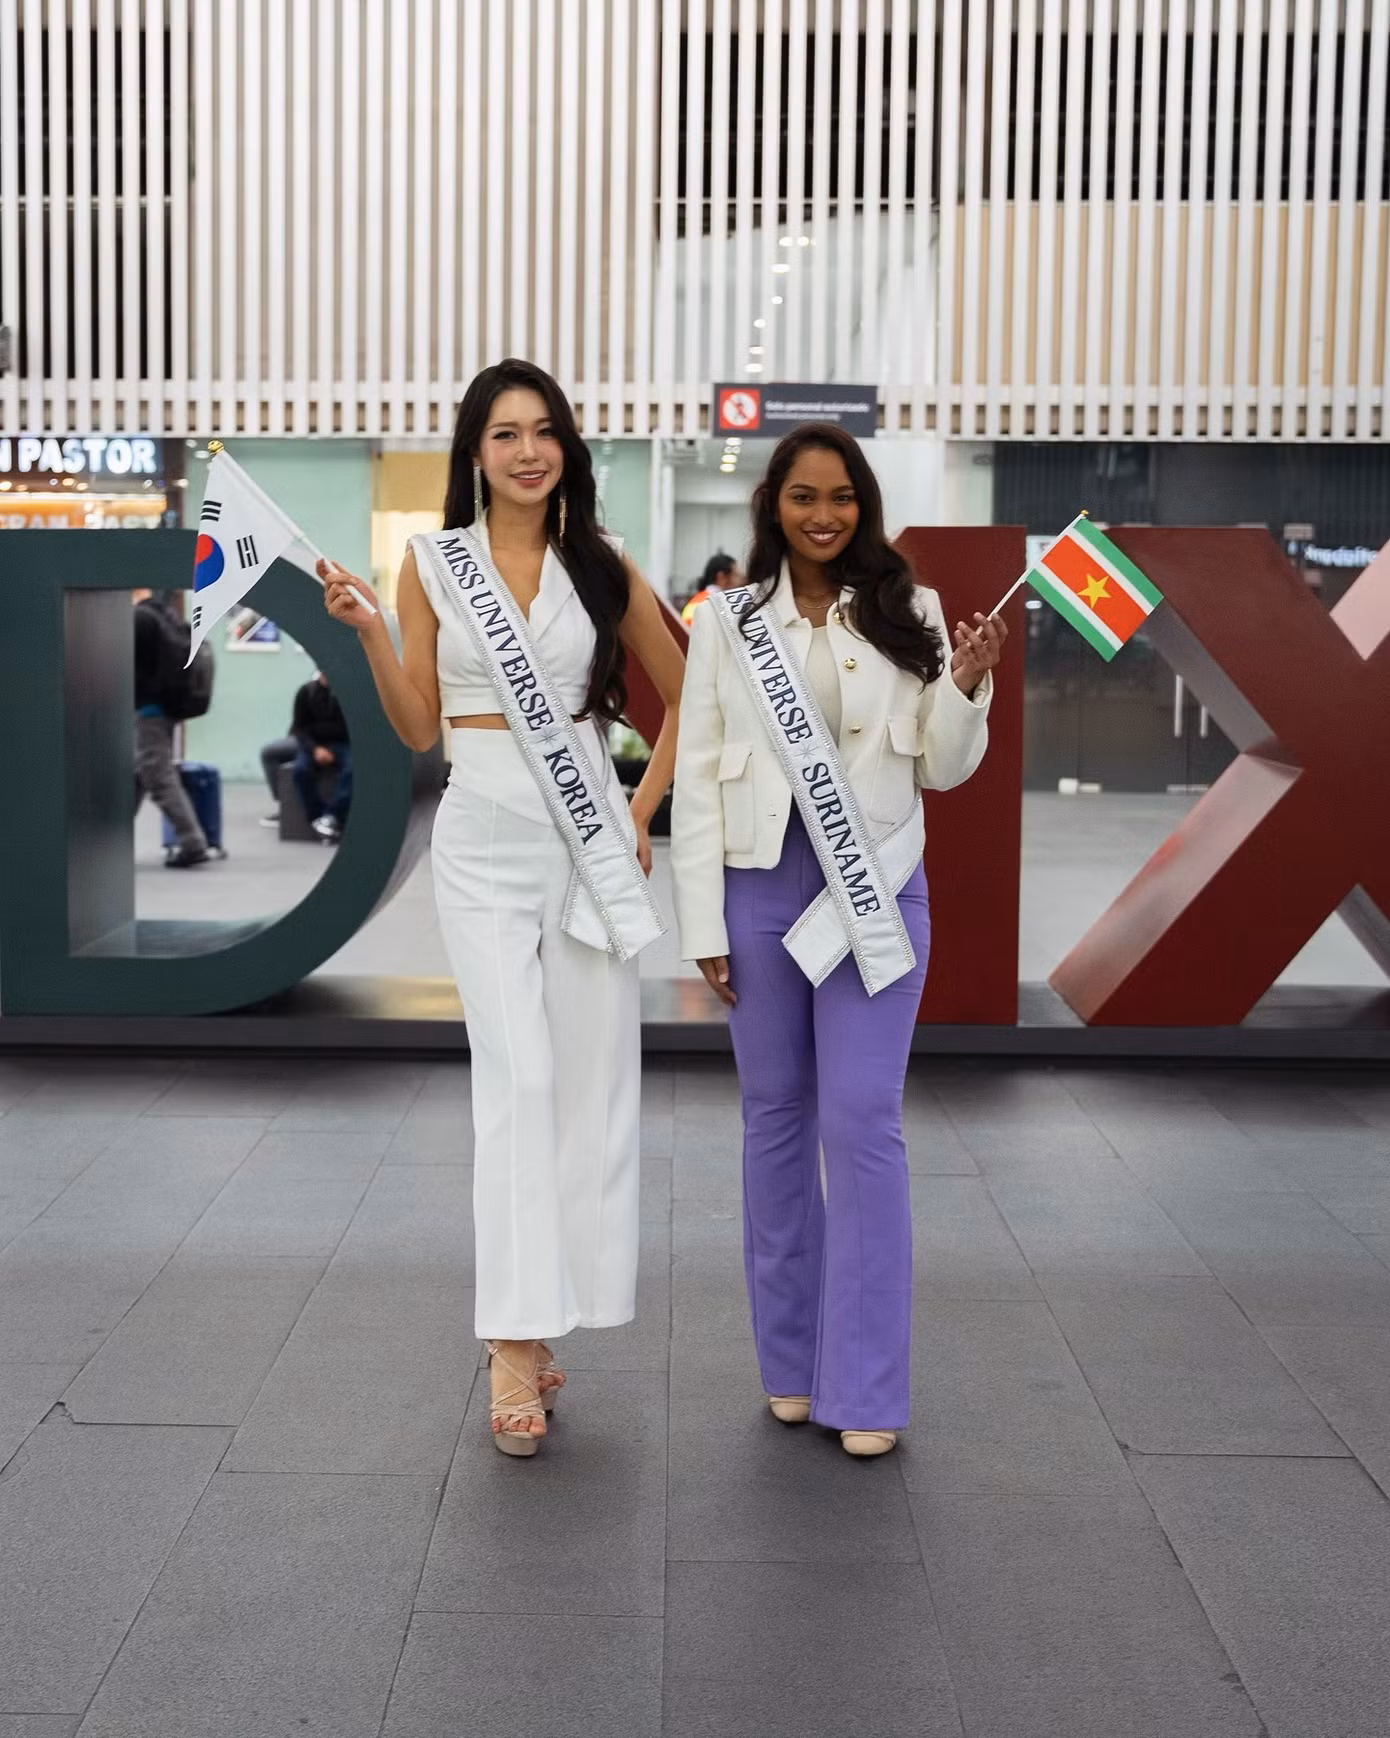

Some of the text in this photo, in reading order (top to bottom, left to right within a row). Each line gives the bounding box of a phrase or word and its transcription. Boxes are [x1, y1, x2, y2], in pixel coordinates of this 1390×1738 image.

[17, 438, 157, 474] PASTOR
[437, 537, 604, 846] MISS UNIVERSE KOREA
[724, 587, 881, 917] ISS UNIVERSE SURINAME
